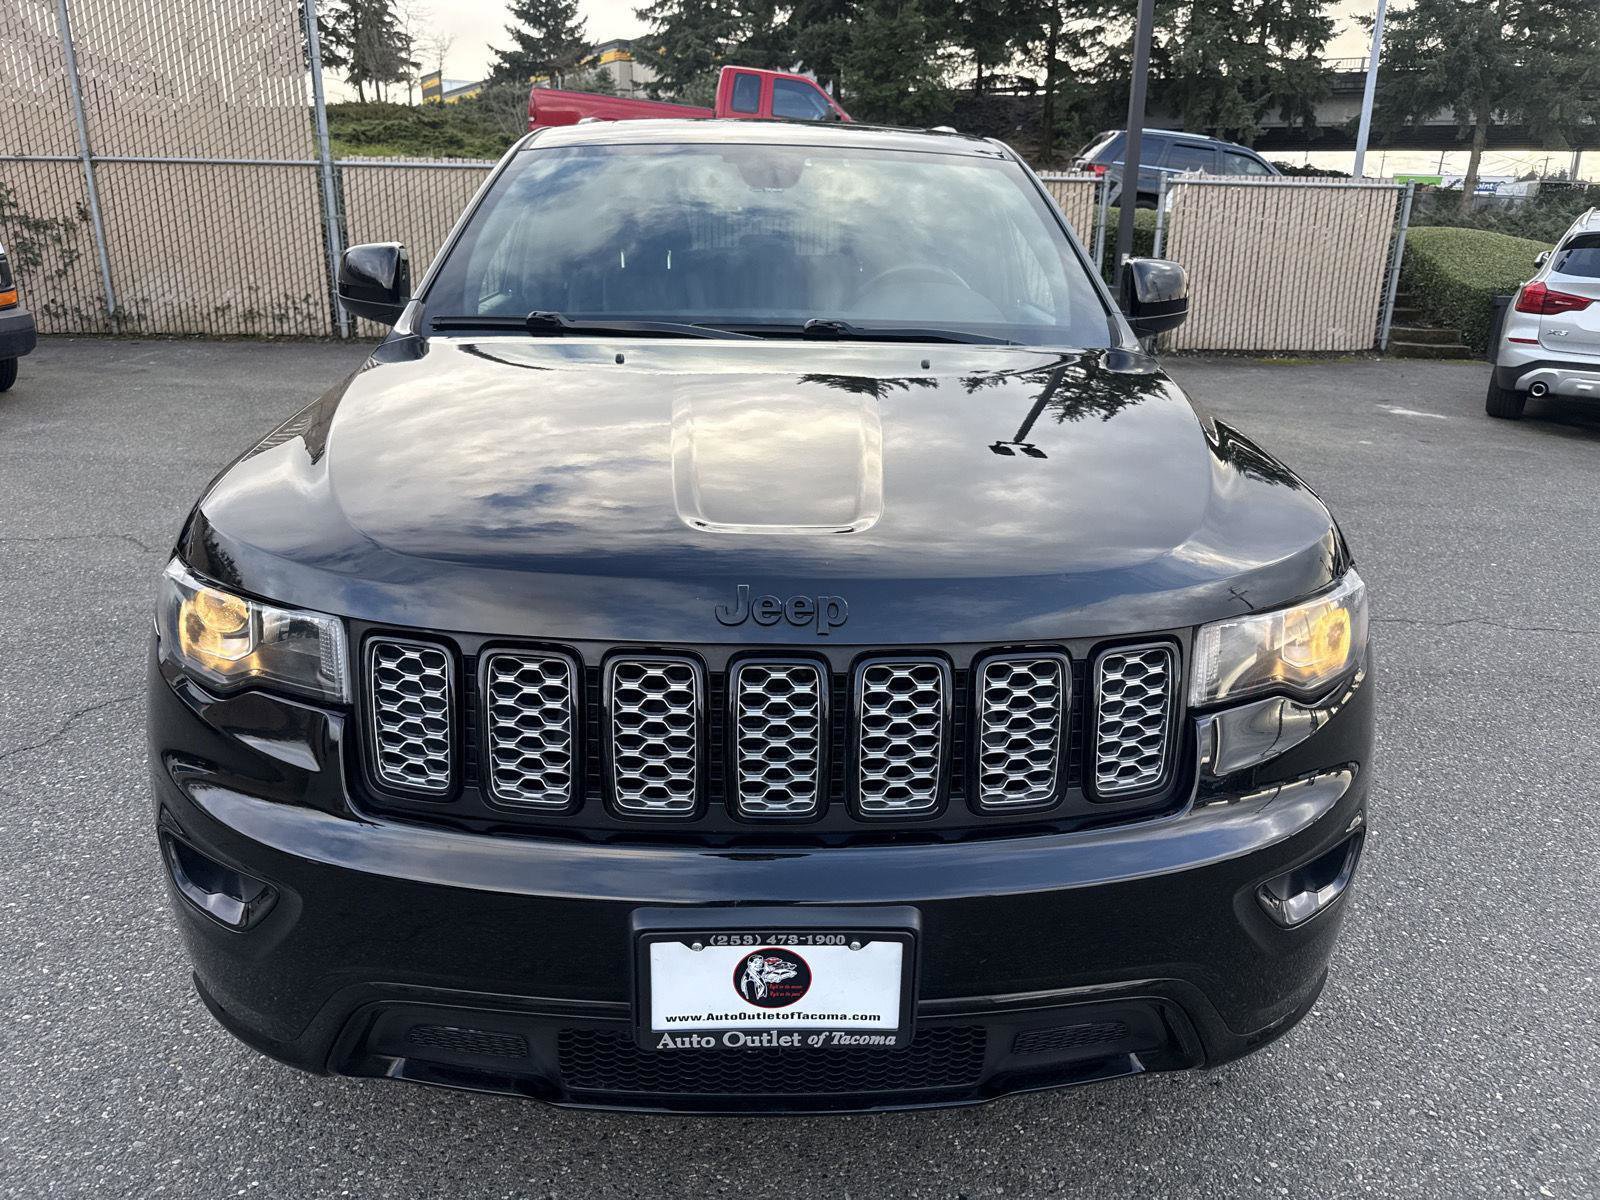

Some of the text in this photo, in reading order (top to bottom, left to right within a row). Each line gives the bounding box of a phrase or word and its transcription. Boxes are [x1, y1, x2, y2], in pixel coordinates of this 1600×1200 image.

[714, 584, 849, 636] Jeep
[709, 935, 846, 946] (253) 473-1900
[665, 1011, 881, 1023] www.AutoOutletofTacoma.com
[657, 1030, 897, 1050] Auto Outlet of Tacoma
